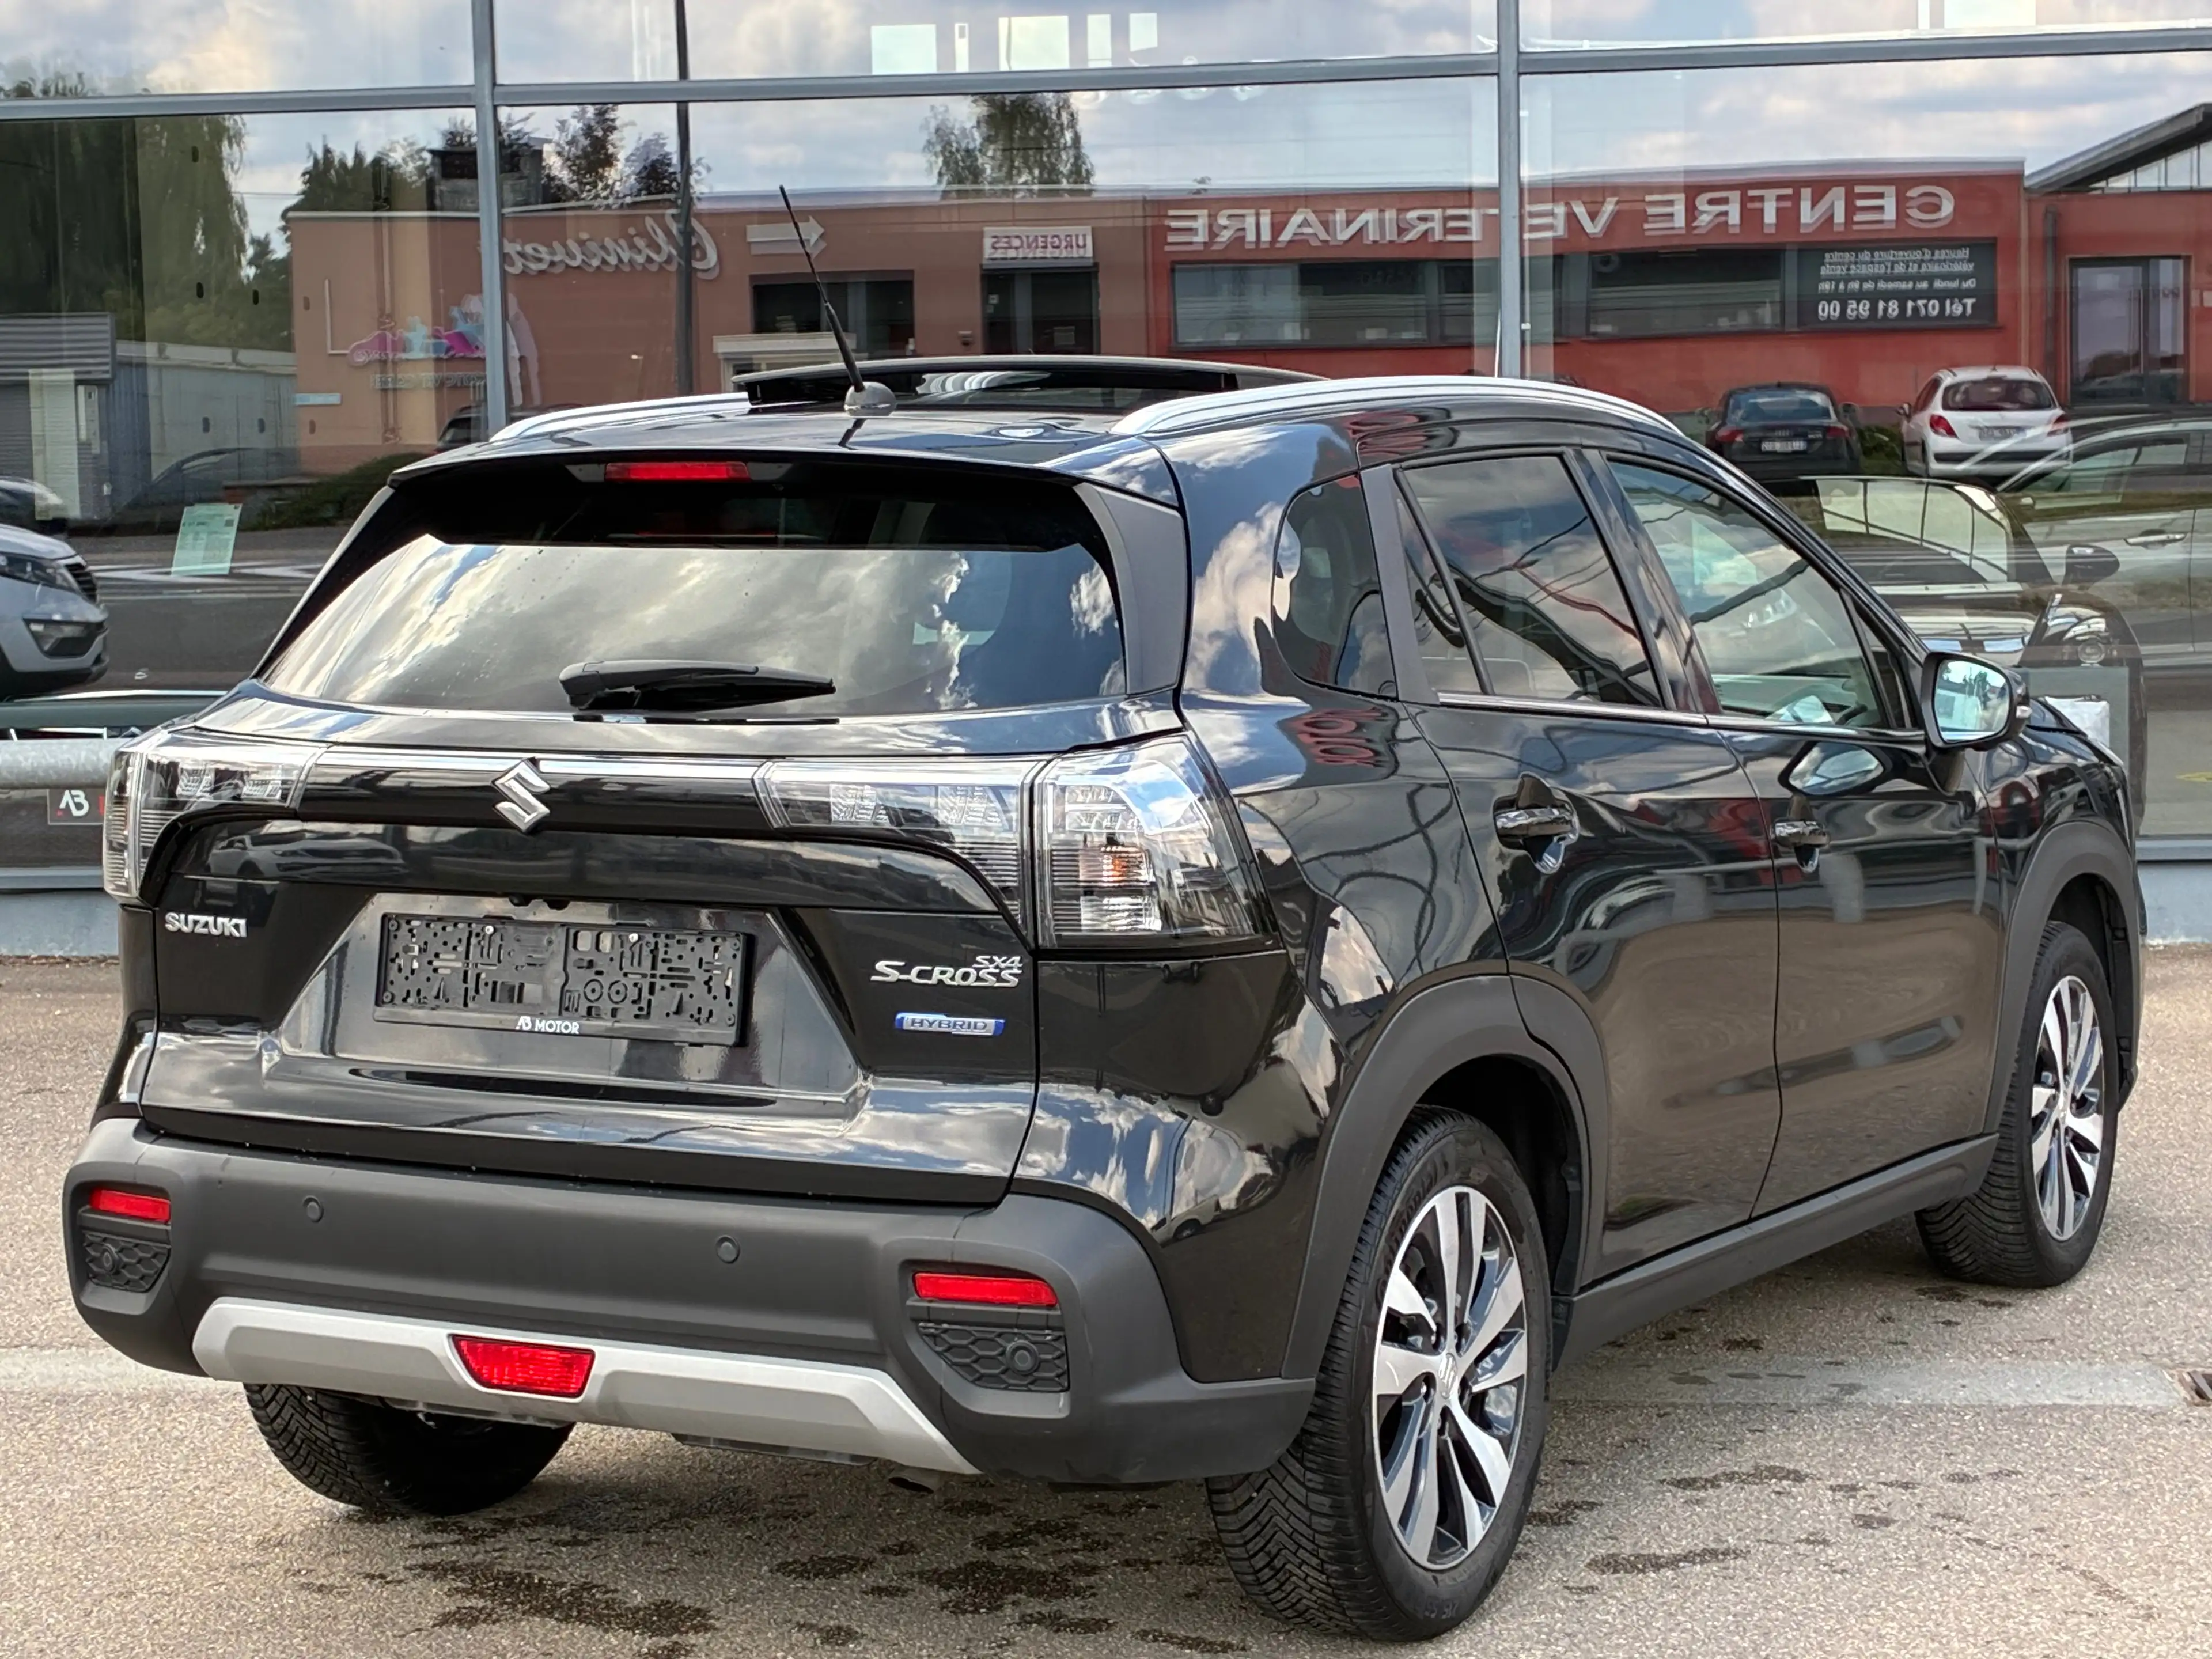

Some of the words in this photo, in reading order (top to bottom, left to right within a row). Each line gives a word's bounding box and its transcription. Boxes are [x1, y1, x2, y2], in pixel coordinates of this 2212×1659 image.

[58, 790, 90, 817] AB
[165, 912, 248, 938] SUZUKI
[972, 956, 1023, 969] SX4
[870, 960, 1022, 988] S-CROSS
[534, 1020, 580, 1035] MOTOR
[910, 1018, 988, 1032] HYBRID
